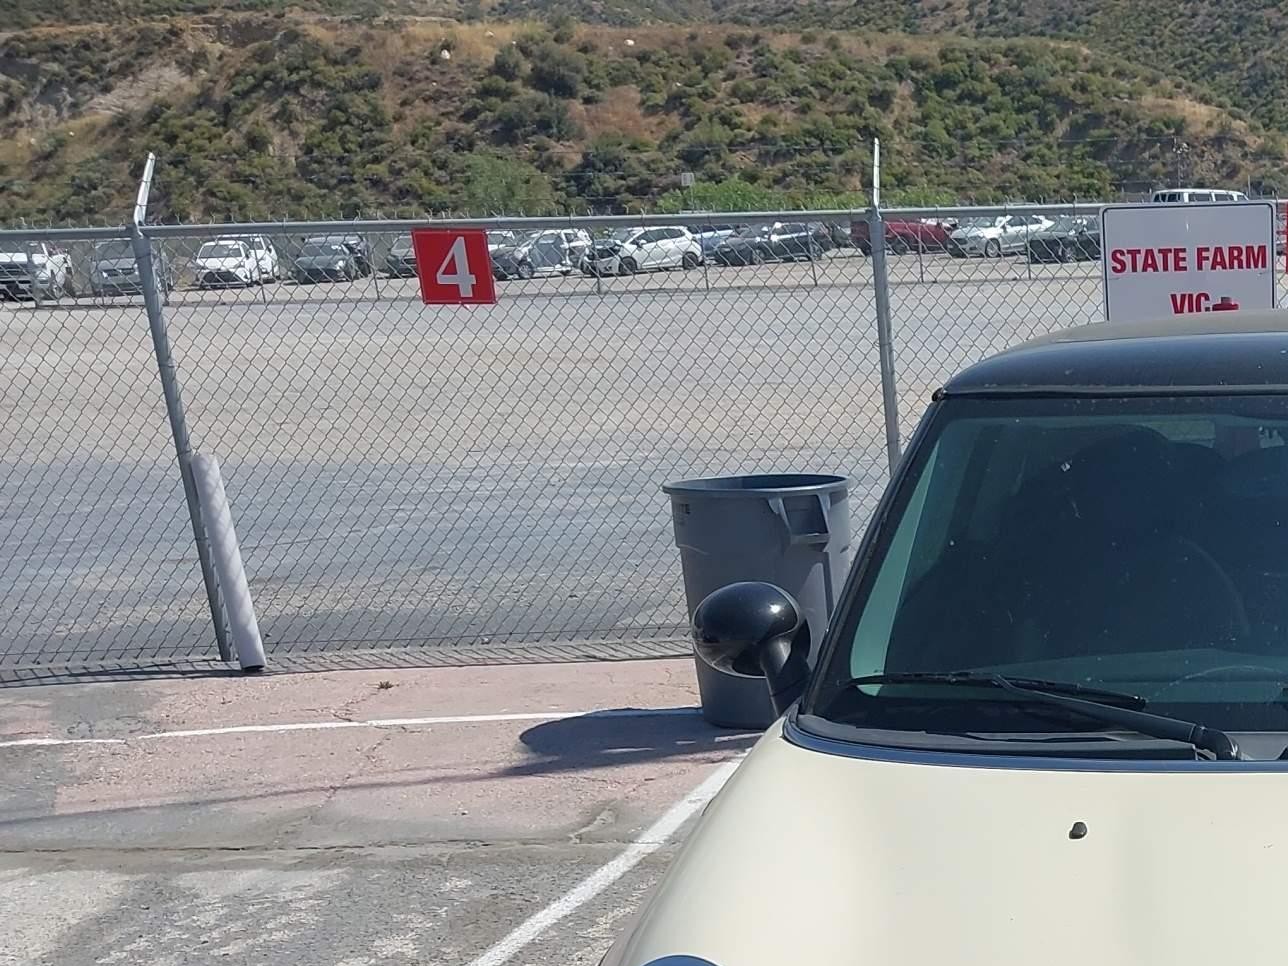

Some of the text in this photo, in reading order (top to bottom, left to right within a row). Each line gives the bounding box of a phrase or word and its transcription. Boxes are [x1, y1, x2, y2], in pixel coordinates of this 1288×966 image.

[436, 236, 477, 298] 4
[1111, 244, 1268, 274] STATE FARM
